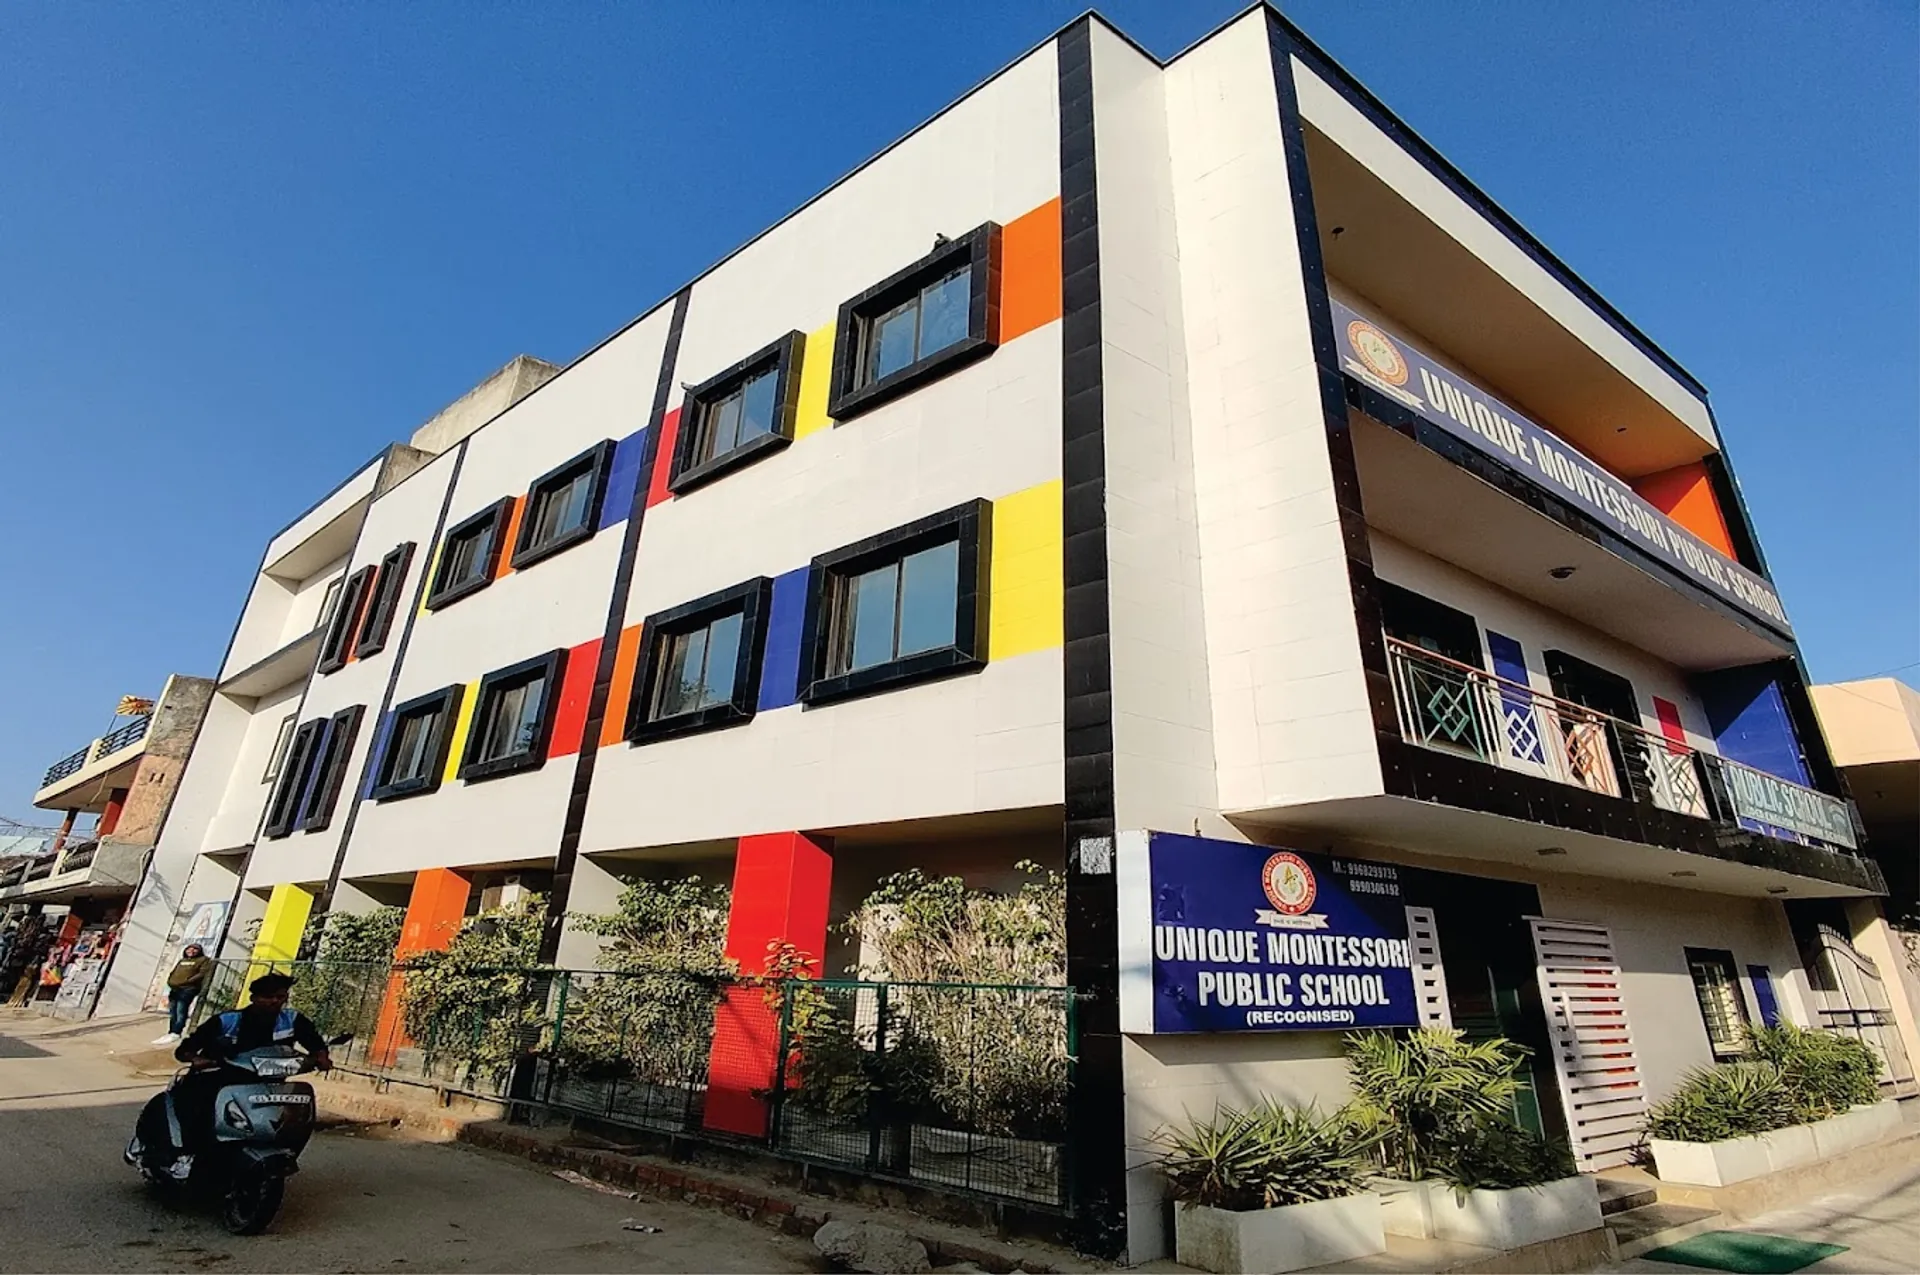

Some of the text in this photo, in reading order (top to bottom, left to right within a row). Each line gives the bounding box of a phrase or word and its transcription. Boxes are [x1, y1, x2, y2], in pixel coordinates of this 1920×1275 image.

[1420, 366, 1790, 626] UNIQUE MONTESSORI PUBLIC SCHOOL
[1729, 765, 1783, 813] PUBLIC
[1780, 783, 1834, 830] SCHOOL
[1155, 925, 1411, 968] UNIQUE MONTESSORI
[1199, 971, 1390, 1007] PUBLIC SCHOOL
[1246, 1010, 1355, 1025] (RECOGNISED)
